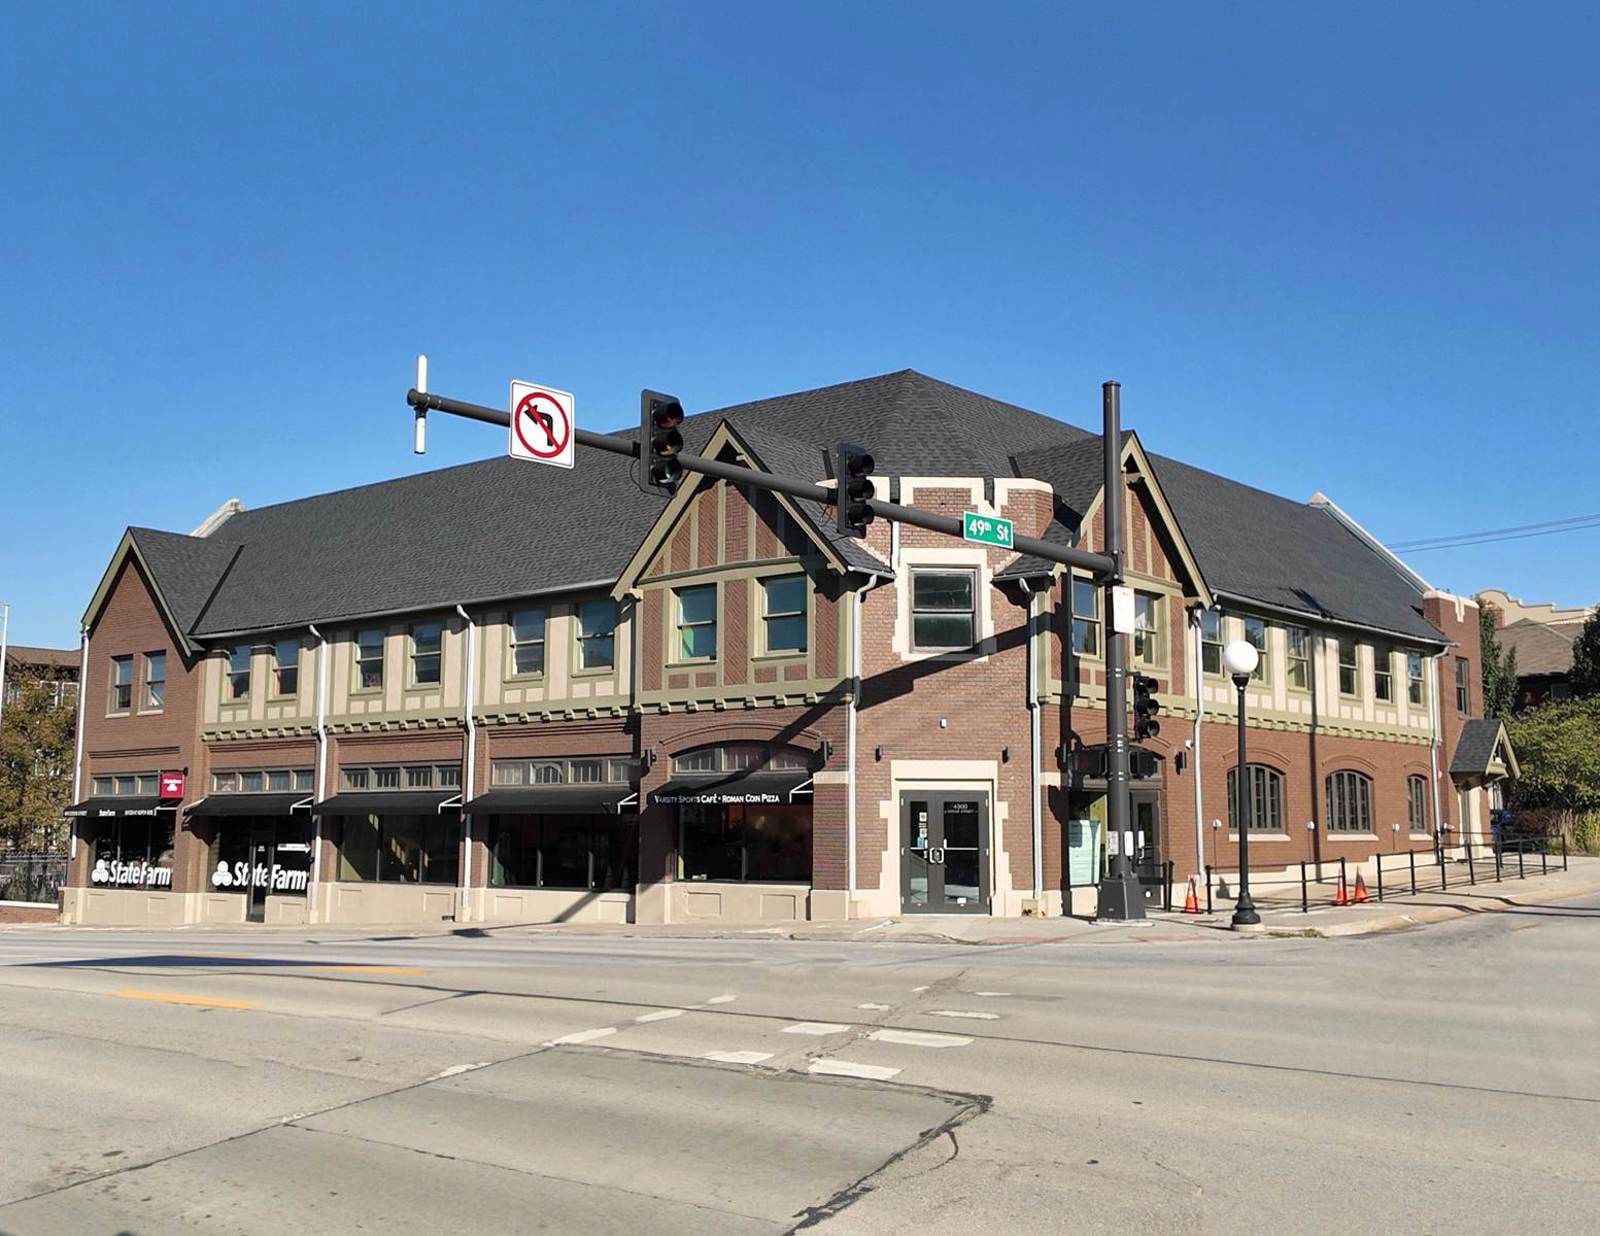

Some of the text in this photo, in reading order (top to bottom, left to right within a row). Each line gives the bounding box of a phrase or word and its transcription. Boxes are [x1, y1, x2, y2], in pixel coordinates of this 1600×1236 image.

[969, 519, 1009, 542] 49th St
[722, 795, 744, 803] ROMAN
[745, 794, 760, 803] COIN
[761, 793, 780, 803] PIZZA
